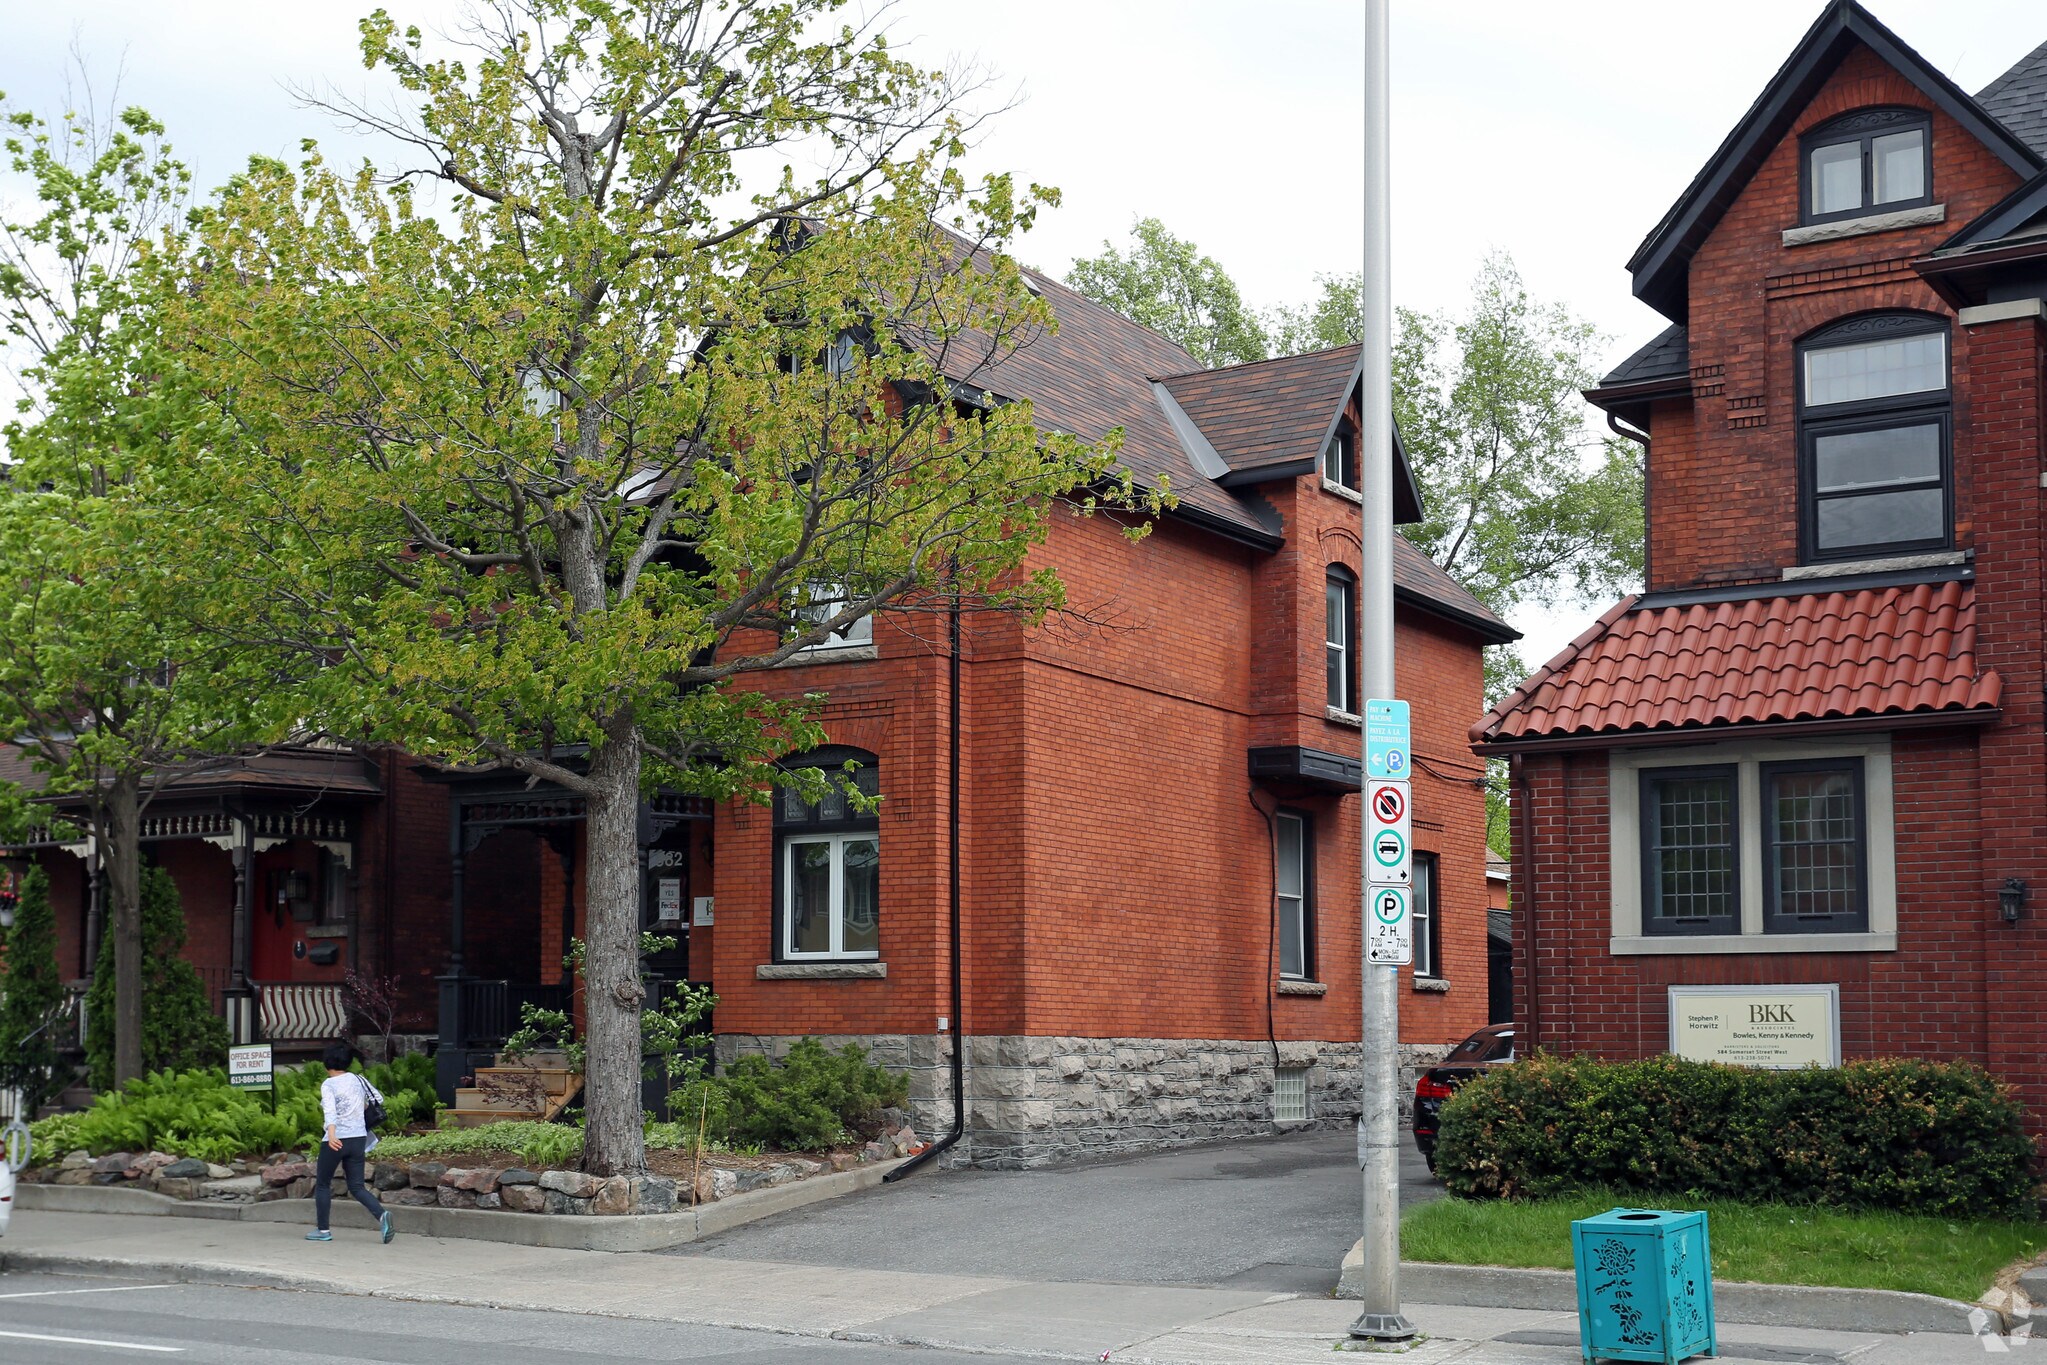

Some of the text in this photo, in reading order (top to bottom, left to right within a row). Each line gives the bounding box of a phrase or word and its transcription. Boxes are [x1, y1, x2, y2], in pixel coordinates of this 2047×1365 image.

[1370, 714, 1392, 722] MACHINE
[1370, 727, 1386, 735] PAYEZ
[1370, 735, 1406, 744] DISTRIBUTRICE
[1384, 898, 1396, 915] P
[1380, 925, 1399, 936] 2 H.
[1749, 1004, 1796, 1023] BKK
[1733, 1032, 1758, 1040] Bowles,
[1759, 1032, 1780, 1040] Kenny
[1785, 1032, 1815, 1040] Kennedy
[231, 1051, 271, 1060] OFFICE SPACE
[236, 1060, 264, 1069] FOR RENT
